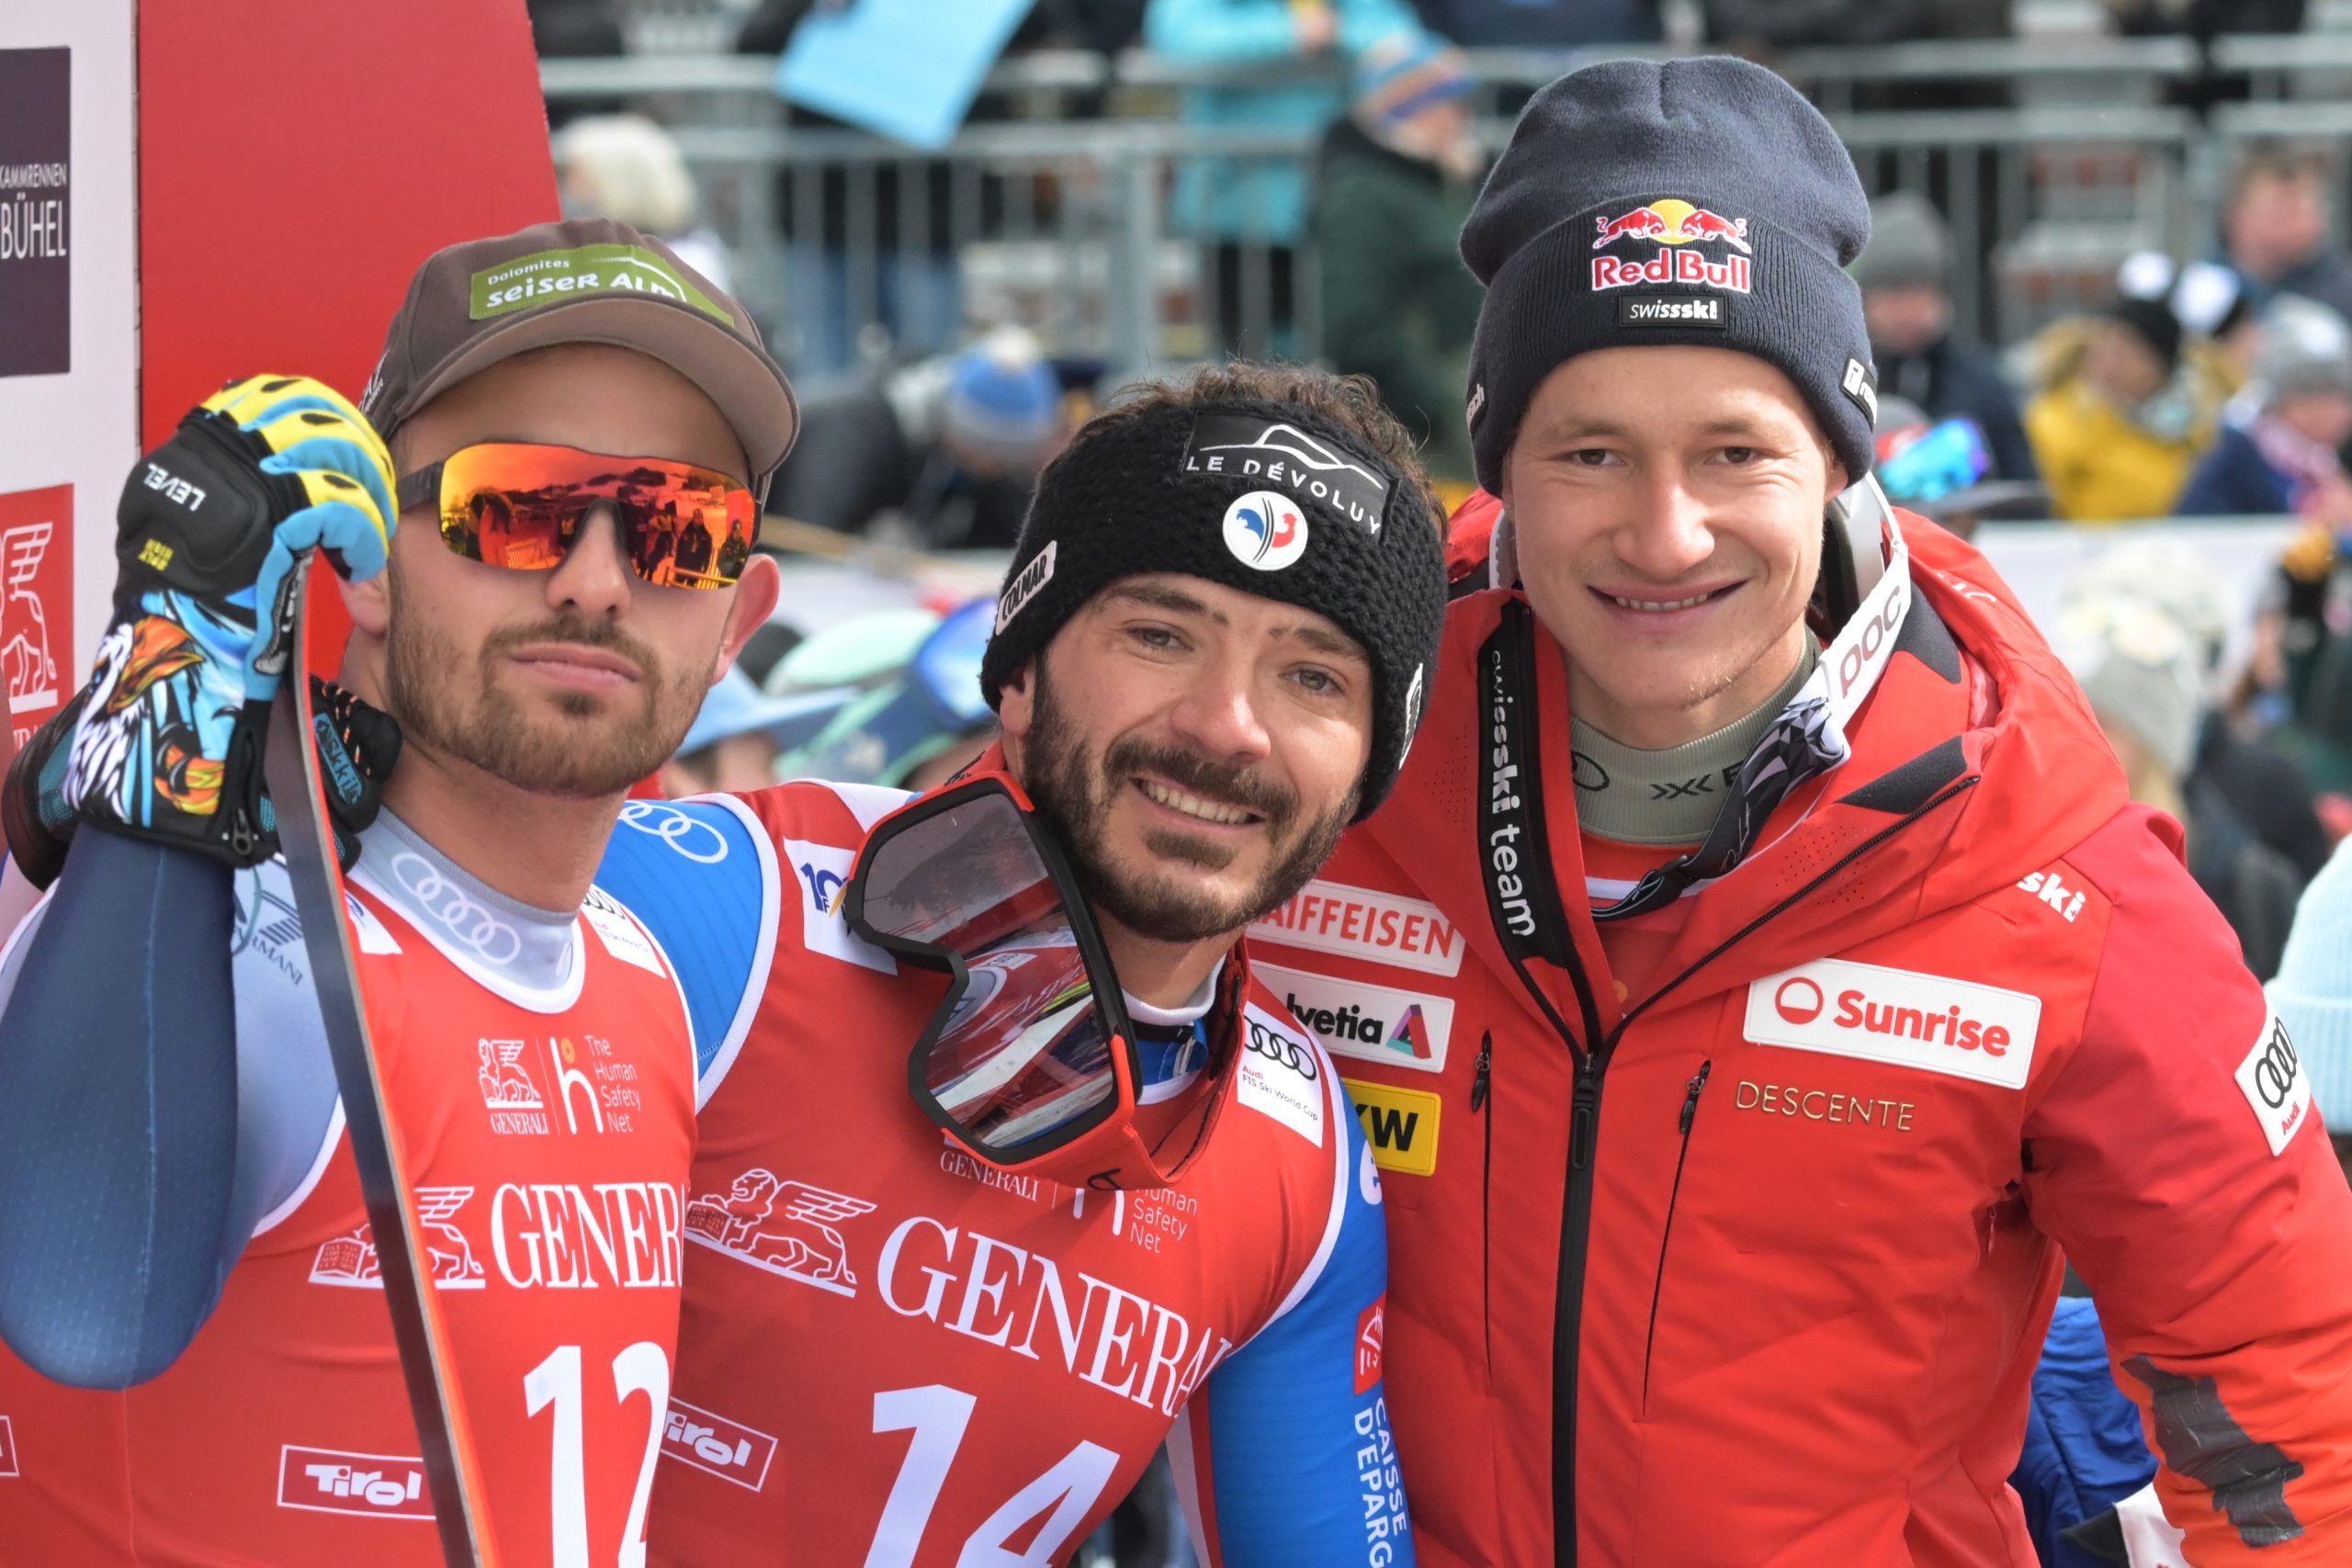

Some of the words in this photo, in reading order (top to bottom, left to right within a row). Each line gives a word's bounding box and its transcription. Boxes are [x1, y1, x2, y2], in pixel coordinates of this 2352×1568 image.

[1, 191, 67, 259] BÜHEL
[488, 260, 570, 286] Dolomites
[1593, 248, 1673, 290] Red
[1676, 249, 1750, 293] Bull
[1630, 299, 1717, 320] swissski
[143, 462, 207, 512] LEVEL
[1186, 457, 1224, 471] LE
[1243, 459, 1381, 535] DÉVOLUY
[1001, 554, 1047, 622] COLMAR
[1839, 584, 1903, 699] POC
[1490, 823, 1536, 936] team
[1255, 893, 1455, 958] AIFFEISEN
[584, 1034, 612, 1057] The
[1833, 989, 2010, 1057] Sunrise
[593, 1061, 639, 1082] Human
[1242, 1065, 1264, 1080] Audi
[600, 1085, 640, 1111] Safety
[606, 1111, 634, 1133] Net
[1242, 1074, 1258, 1088] FIS
[1259, 1081, 1273, 1095] Ski
[1274, 1088, 1302, 1110] World
[1303, 1104, 1318, 1122] Cup
[1736, 1080, 1916, 1132] DESCENTE
[490, 1112, 549, 1134] GENERALI
[1129, 1222, 1161, 1254] Net
[1133, 1198, 1188, 1242] Safety
[523, 1340, 671, 1568] 12
[863, 1383, 1122, 1568] 14
[1375, 1396, 1408, 1536] CAISSE
[305, 1463, 423, 1507] Tirol
